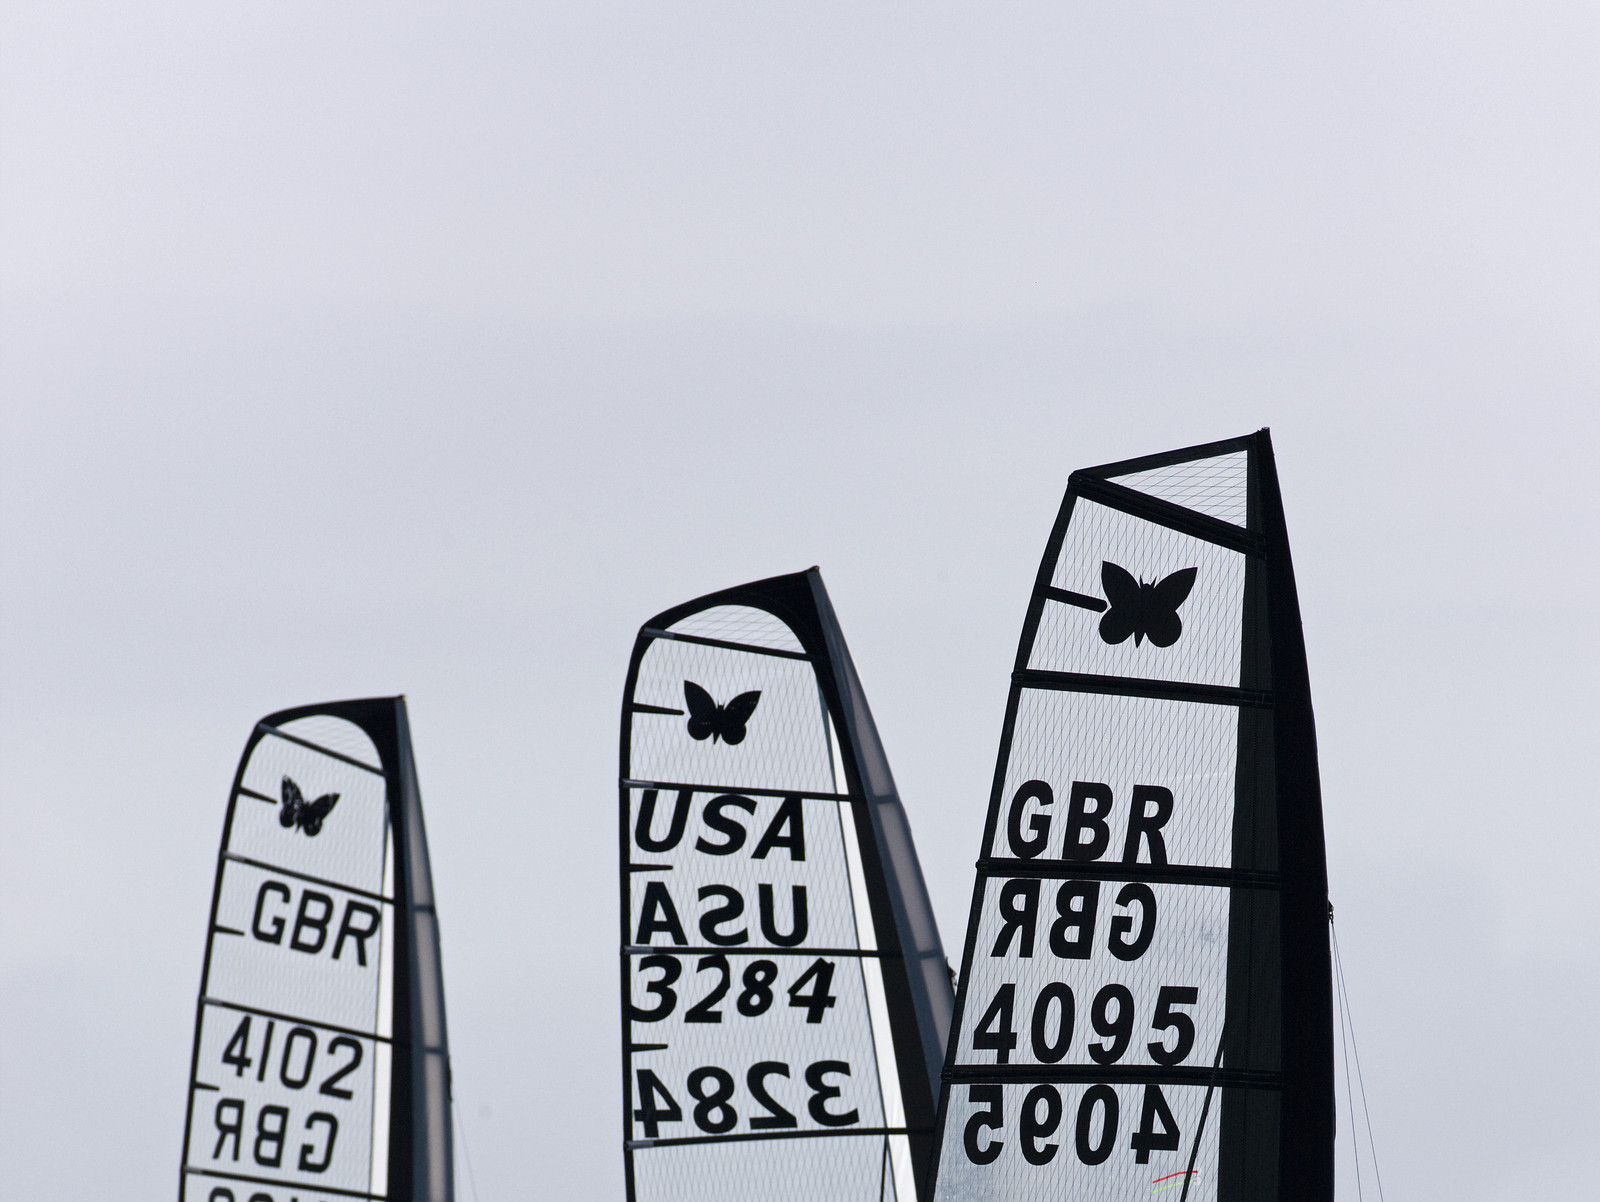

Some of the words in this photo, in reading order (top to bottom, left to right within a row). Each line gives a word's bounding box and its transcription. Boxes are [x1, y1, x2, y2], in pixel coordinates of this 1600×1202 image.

[634, 789, 806, 862] USA
[1006, 779, 1174, 866] GBR
[251, 880, 382, 967] GBR
[631, 954, 837, 1024] 3284
[972, 981, 1199, 1066] 4095
[221, 1015, 364, 1101] 4102
